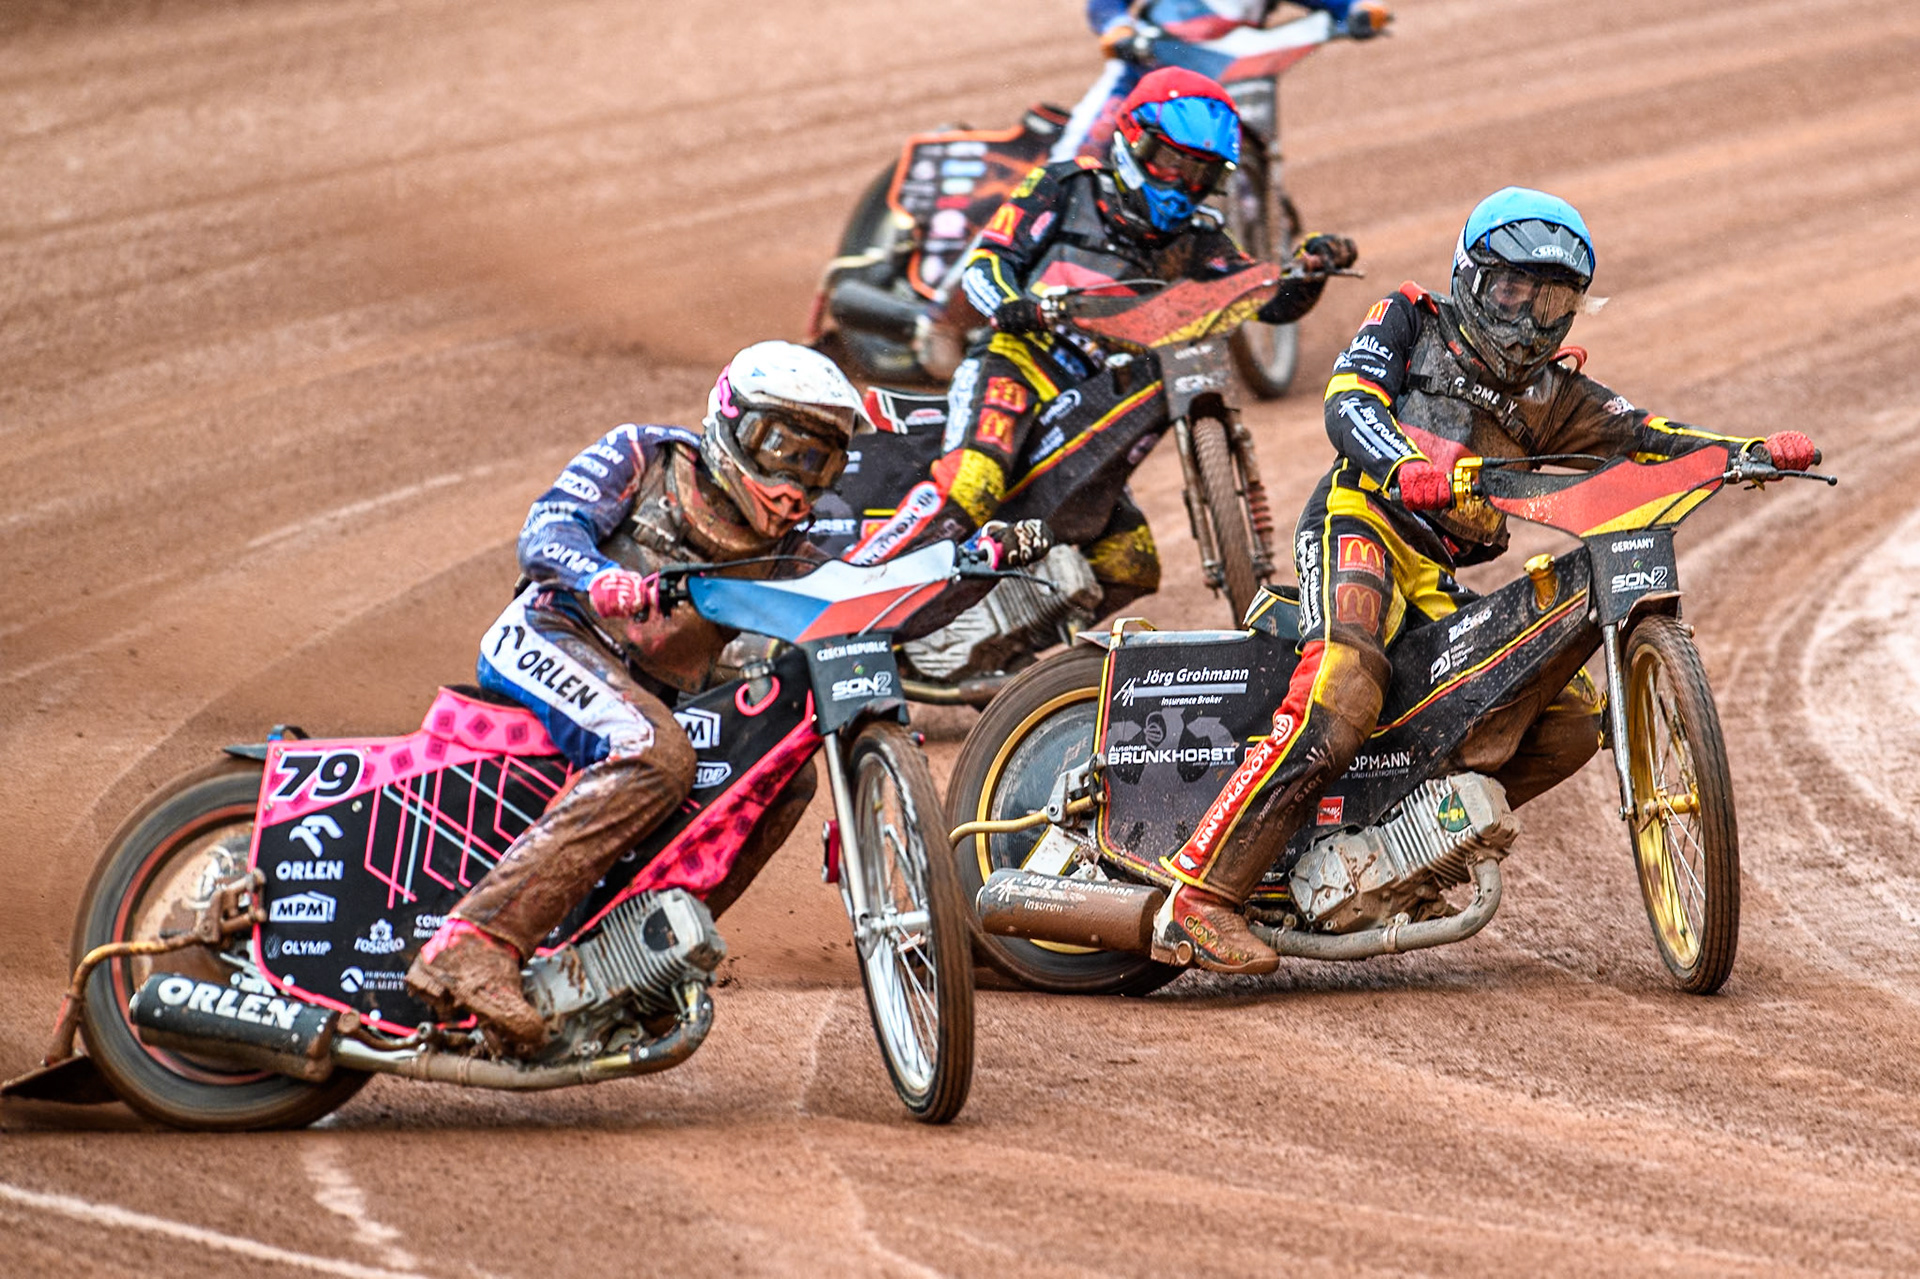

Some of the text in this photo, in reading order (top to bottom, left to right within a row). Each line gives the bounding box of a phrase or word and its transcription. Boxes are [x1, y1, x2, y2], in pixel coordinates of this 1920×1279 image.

[1611, 537, 1655, 553] GERMANY
[846, 641, 888, 655] REPUBLIC
[517, 650, 599, 710] ORLEN
[1143, 667, 1249, 686] Jörg Grohmann
[1161, 695, 1222, 706] Insurance Broker
[1108, 747, 1236, 765] BRUNKHORST
[269, 750, 364, 801] 79
[1197, 743, 1273, 851] KOOPMANN
[275, 860, 344, 880] ORLEN
[1023, 874, 1057, 889] Jörg
[277, 902, 324, 916] MPM
[281, 940, 332, 956] OLYMP
[158, 977, 303, 1030] ORLEN
